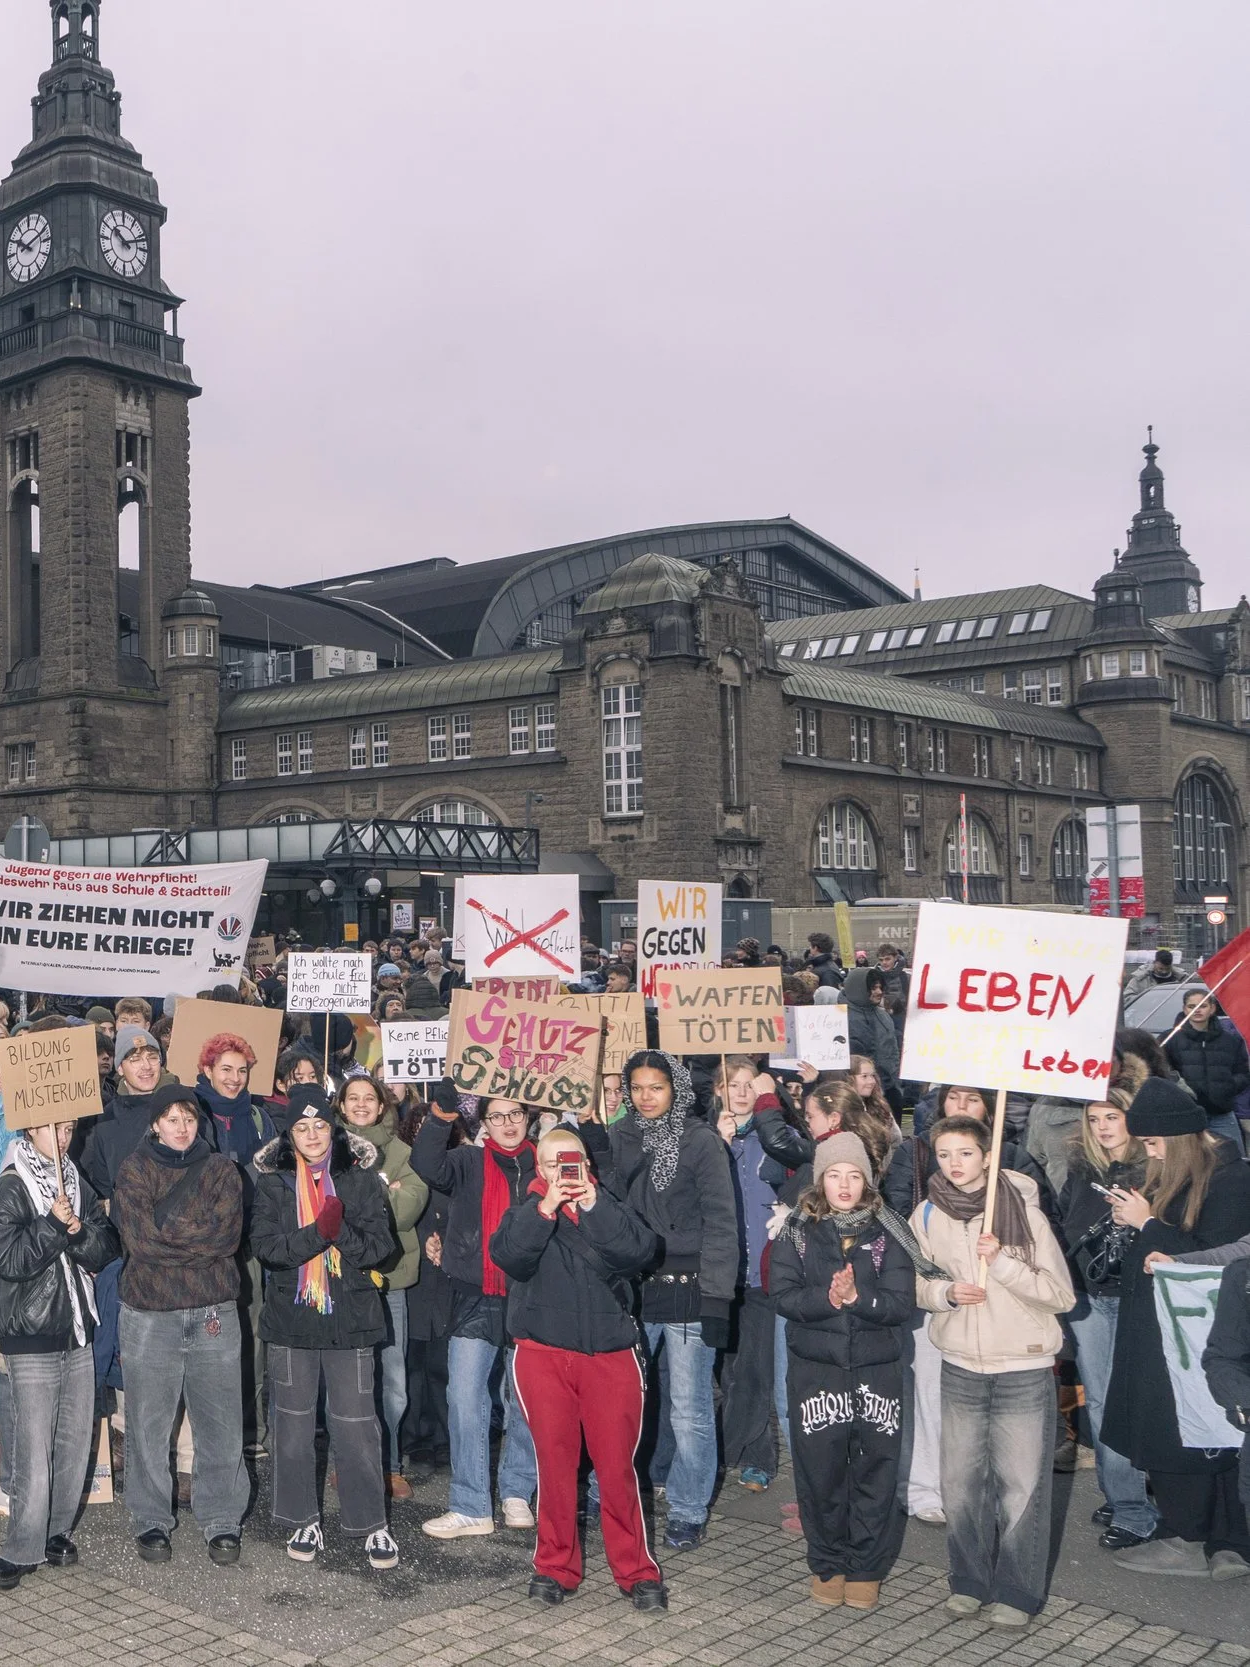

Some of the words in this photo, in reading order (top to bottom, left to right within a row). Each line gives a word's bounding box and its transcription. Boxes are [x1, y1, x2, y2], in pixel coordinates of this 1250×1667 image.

[5, 864, 51, 877] Jugend
[53, 869, 91, 881] gegen
[93, 871, 112, 881] die
[115, 872, 198, 885] Wehrpflicht!
[53, 882, 82, 892] raus
[85, 884, 108, 893] aus
[112, 884, 155, 896] Schule
[158, 886, 167, 896] &
[170, 885, 231, 897] Stadtteil!
[37, 902, 127, 926] ZIEHEN
[132, 908, 214, 929] NICHT
[657, 887, 707, 922] WIR
[26, 928, 88, 951] EURE
[94, 934, 195, 957] KRIEGE!
[642, 926, 706, 958] GEGEN
[292, 969, 307, 980] der
[312, 968, 345, 980] Schule
[349, 968, 367, 981] frei
[294, 955, 307, 968] Ich
[312, 956, 339, 968] wollte
[343, 957, 363, 967] nach
[292, 981, 320, 993] haben
[334, 982, 358, 994] nicht
[917, 963, 1095, 1020] LEBEN
[291, 994, 345, 1011] eingezogen
[388, 1029, 420, 1042] Keine
[425, 1027, 449, 1040] Pflic
[465, 995, 600, 1056] SCHUTZ
[678, 1014, 786, 1043] TÖTEN!
[7, 1037, 70, 1066] BILDUNG
[408, 1048, 435, 1057] zum
[498, 1045, 568, 1075] STATT
[28, 1058, 74, 1083] STATT
[388, 1057, 446, 1076] TÖTE
[14, 1079, 97, 1112] MUSTERUNG!
